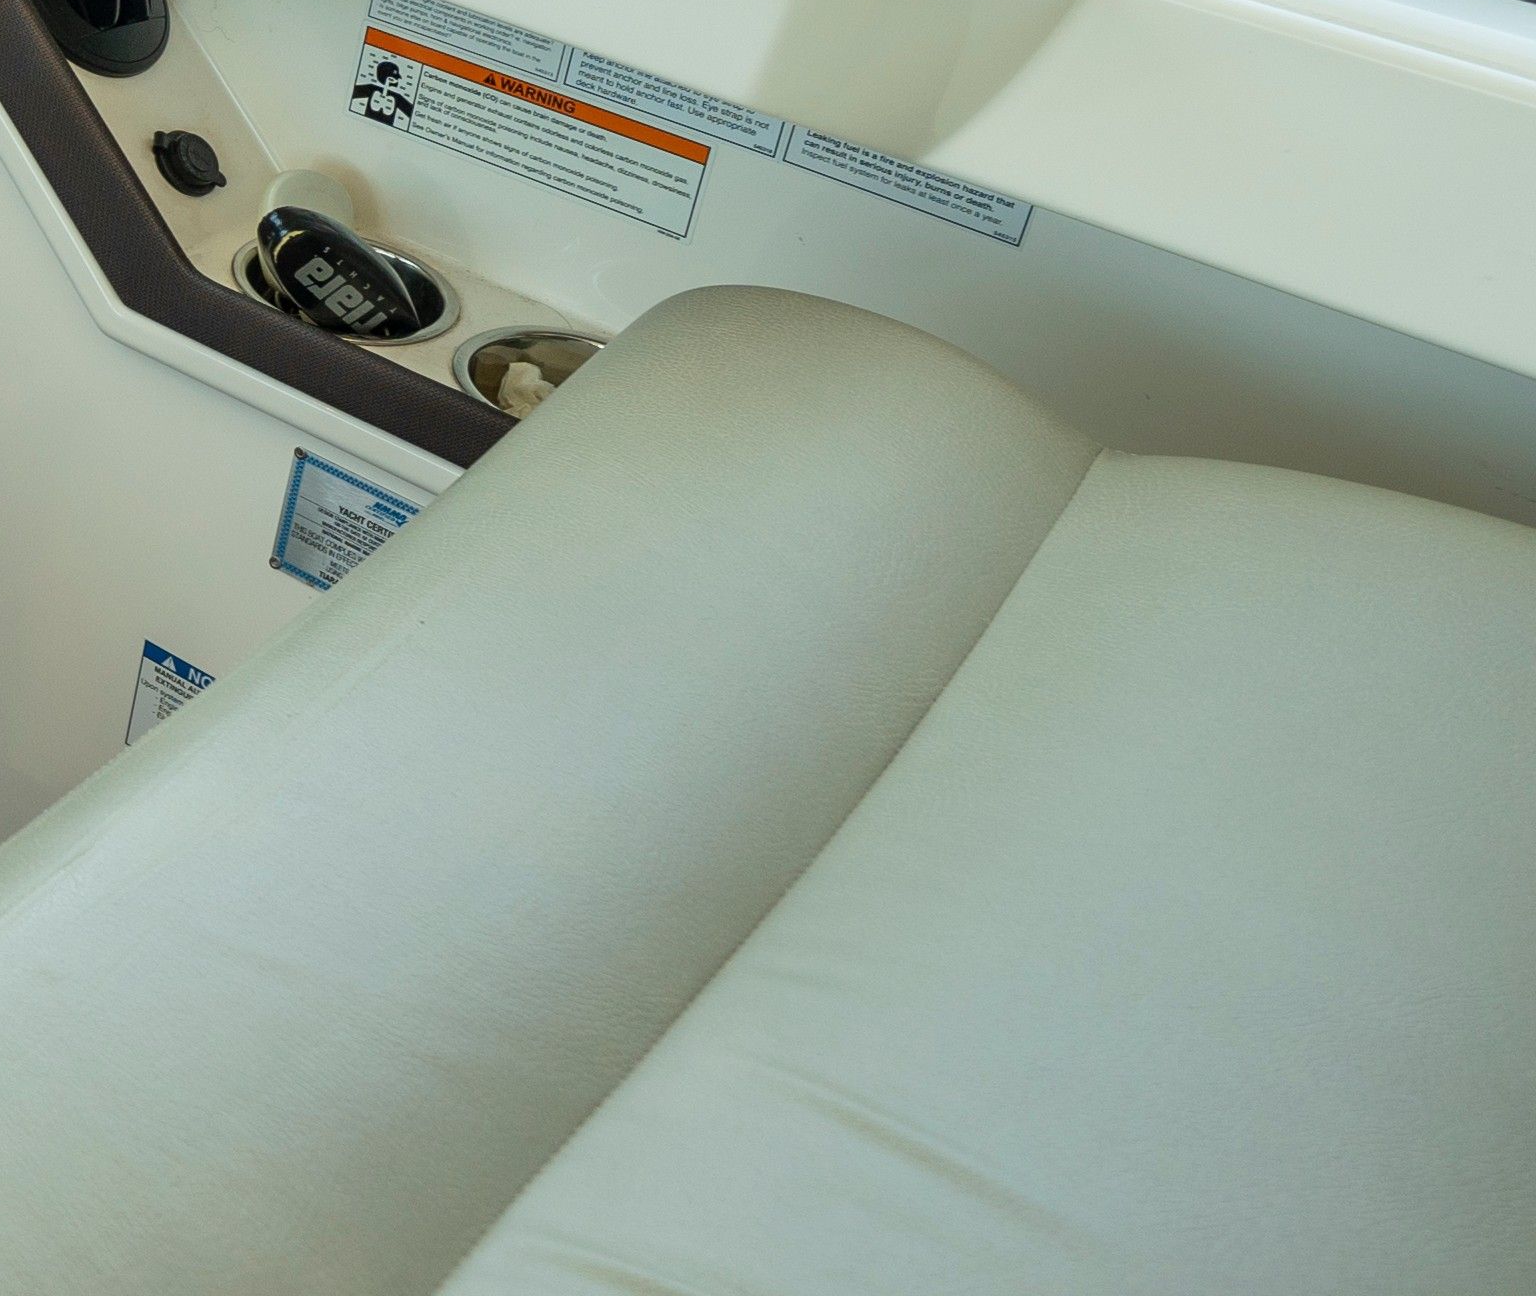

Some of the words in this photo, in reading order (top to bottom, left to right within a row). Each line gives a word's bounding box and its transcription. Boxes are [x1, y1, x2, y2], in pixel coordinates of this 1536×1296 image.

[424, 71, 447, 84] Carbon
[448, 80, 481, 96] monoxide
[482, 92, 498, 103] (CO)
[499, 98, 511, 107] can
[512, 103, 531, 115] cause
[532, 110, 549, 121] brain
[550, 117, 577, 132] damage
[498, 76, 577, 115] WARNING
[575, 78, 595, 90] deck
[578, 68, 604, 83] meant
[605, 78, 614, 86] to
[615, 81, 634, 93] hold
[635, 88, 665, 104] anchor
[686, 106, 705, 118] Use
[706, 113, 756, 137] appropriate
[580, 60, 611, 76] prevent
[612, 71, 641, 86] anchor
[644, 81, 660, 92] and
[661, 87, 677, 98] line
[701, 100, 719, 113] Eye
[720, 108, 743, 122] strap
[745, 116, 752, 124] is
[754, 119, 769, 129] not
[420, 82, 442, 96] Engine
[443, 90, 455, 100] and
[456, 96, 485, 111] generator
[570, 137, 582, 145] and
[614, 153, 639, 166] carbon
[639, 162, 673, 178] monoxide
[800, 148, 830, 164] Inspect
[832, 159, 847, 170] fuel
[848, 166, 878, 182] system
[880, 177, 891, 186] for
[893, 181, 916, 194] leaks
[928, 194, 949, 206] least
[950, 203, 972, 214] once
[804, 139, 819, 149] can
[821, 145, 846, 159] result
[848, 155, 857, 163] in
[859, 159, 892, 176] serious
[924, 181, 952, 196] burns
[953, 193, 963, 201] or
[965, 196, 994, 212] death.
[806, 128, 841, 148] Leaking
[843, 142, 859, 153] fuel
[861, 148, 869, 157] is
[879, 155, 895, 166] fire
[896, 161, 913, 173] and
[914, 167, 960, 190] explosion
[961, 184, 994, 201] hazard
[995, 196, 1015, 208] that
[294, 257, 388, 334] tiara
[337, 505, 365, 524] YACHT
[153, 665, 188, 688] MANUAL
